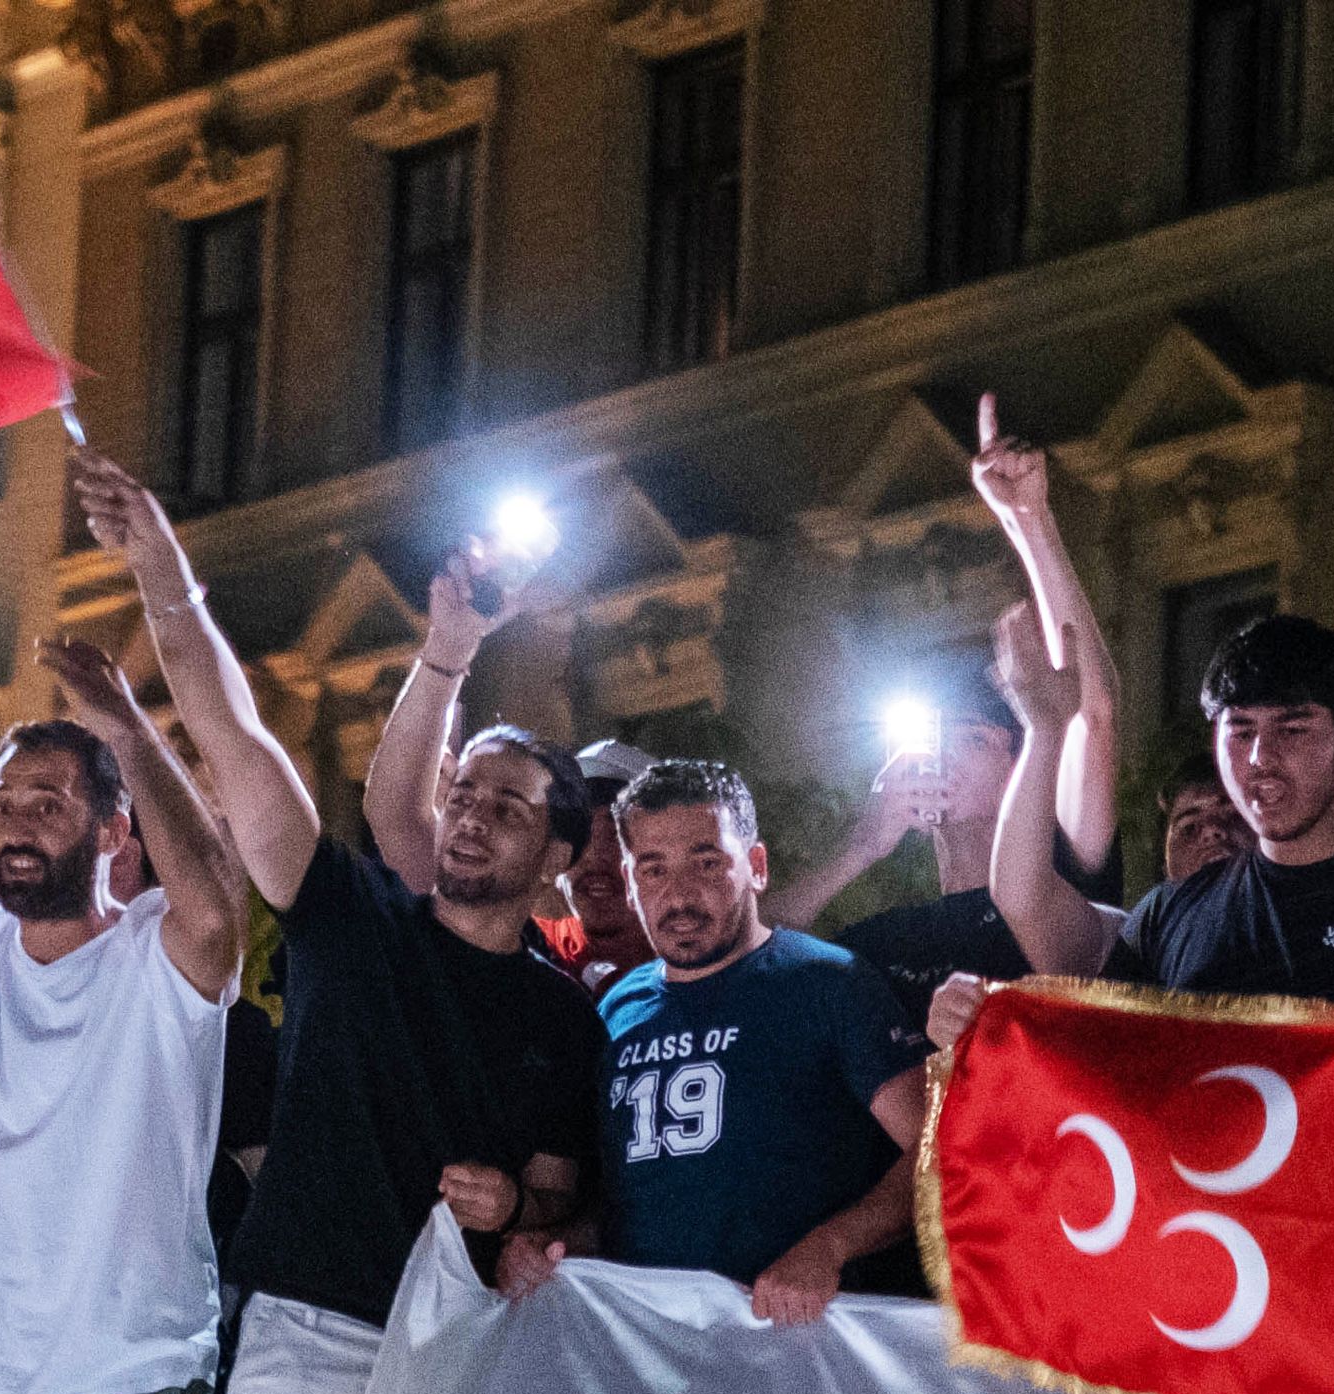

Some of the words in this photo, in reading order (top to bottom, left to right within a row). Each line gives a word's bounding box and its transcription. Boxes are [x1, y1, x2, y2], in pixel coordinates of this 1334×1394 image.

[618, 1032, 693, 1068] CLASS
[704, 1027, 739, 1053] OF
[610, 1061, 726, 1163] '19
